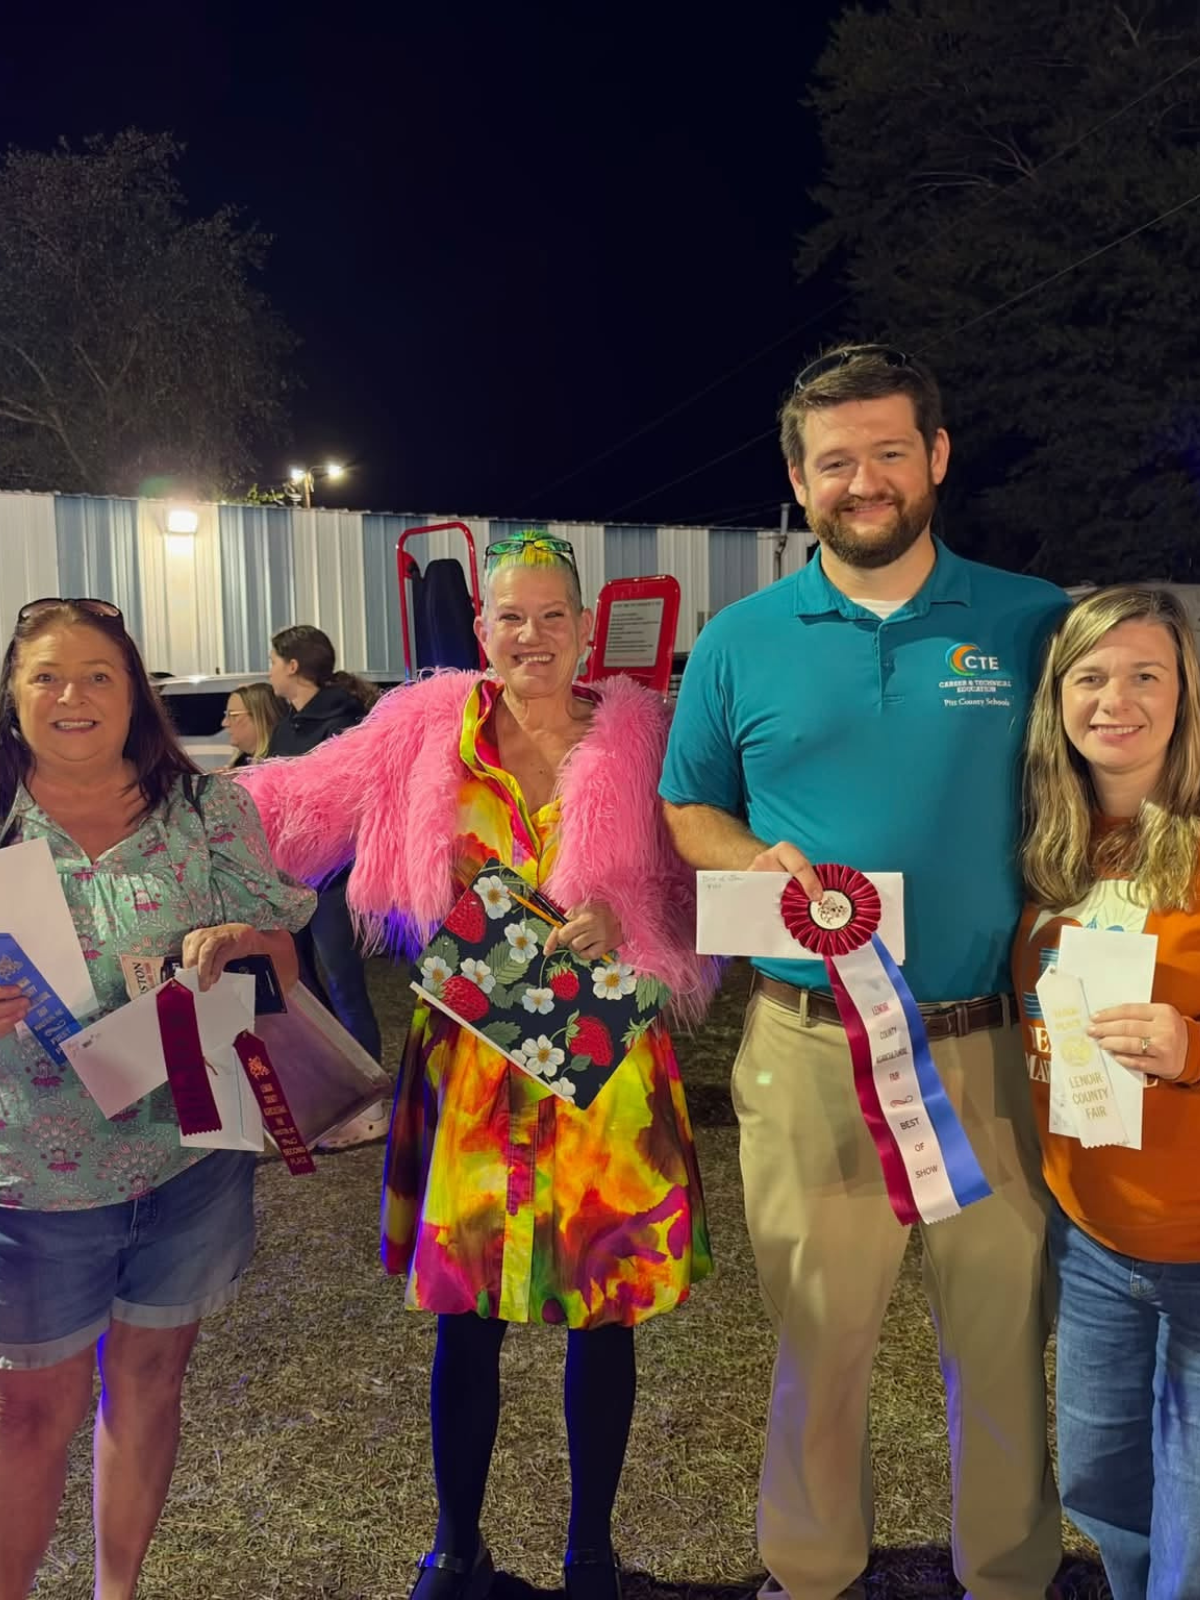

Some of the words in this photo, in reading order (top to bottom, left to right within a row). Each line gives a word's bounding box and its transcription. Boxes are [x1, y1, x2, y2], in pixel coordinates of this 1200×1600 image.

[964, 655, 999, 671] CTE
[938, 680, 967, 689] CAREER
[958, 698, 985, 709] County
[985, 698, 1010, 707] Schools
[880, 1026, 897, 1040] COUNTY
[888, 1070, 900, 1082] FAIR
[1070, 1072, 1103, 1089] LENOIR
[1072, 1087, 1109, 1105] COUNTY
[1085, 1105, 1107, 1120] FAIR
[899, 1117, 920, 1131] BEST
[914, 1142, 925, 1152] OF
[915, 1164, 938, 1179] SHOW
